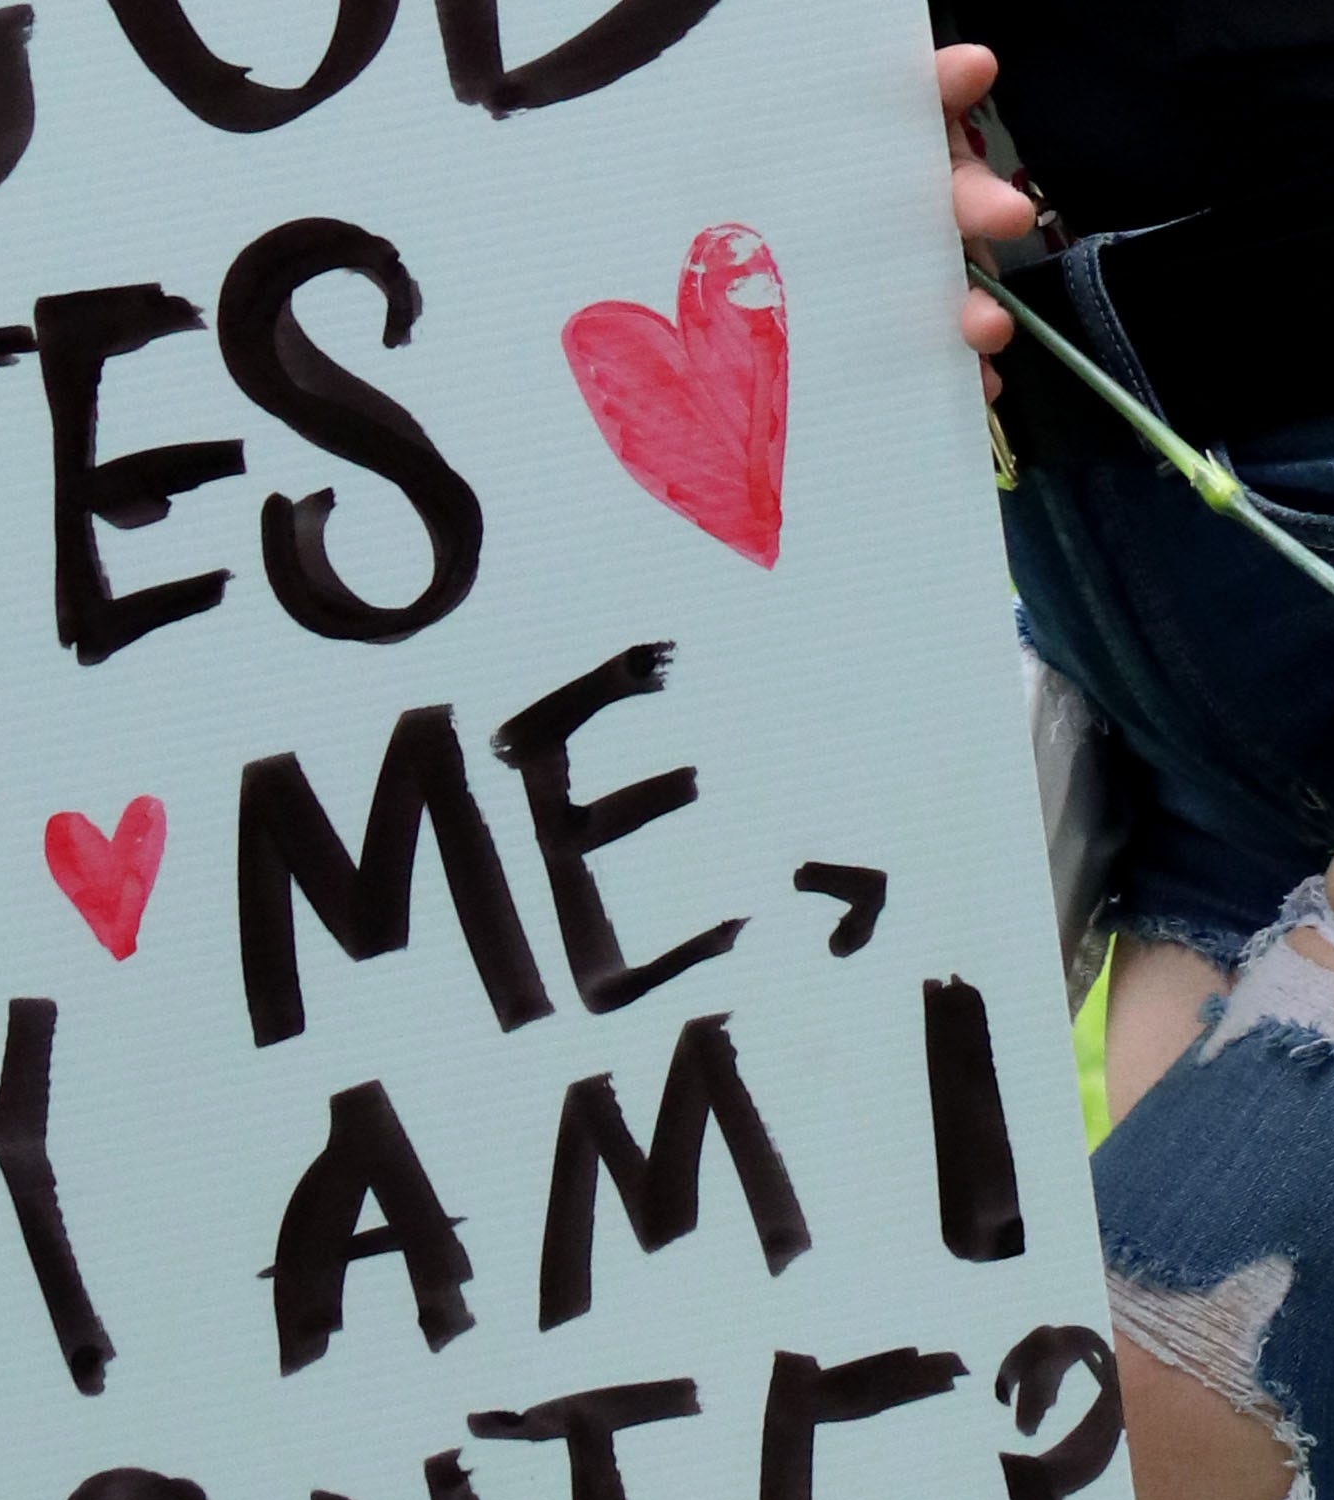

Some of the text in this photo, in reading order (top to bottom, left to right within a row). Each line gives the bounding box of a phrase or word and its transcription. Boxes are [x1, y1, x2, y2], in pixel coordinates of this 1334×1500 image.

[238, 640, 889, 1048] ME,
[256, 1013, 812, 1377] AM
[922, 973, 1026, 1263] I
